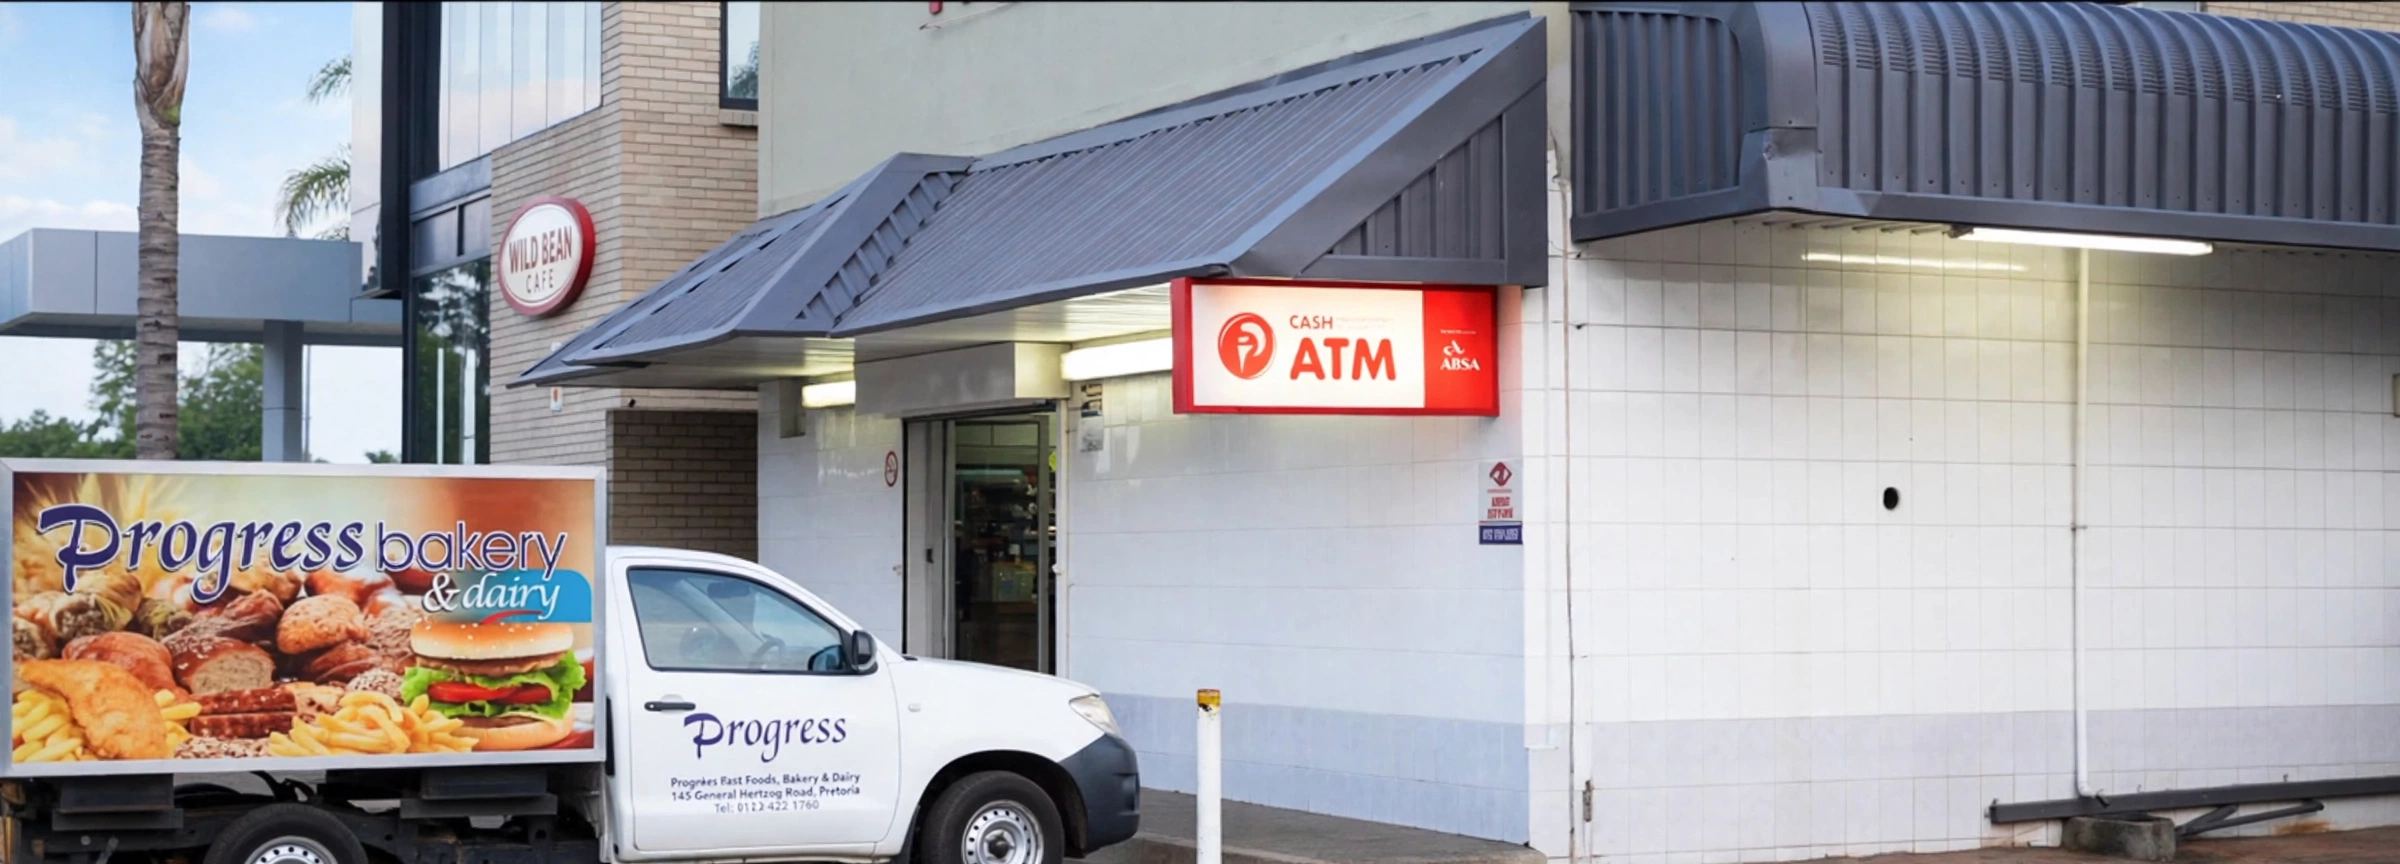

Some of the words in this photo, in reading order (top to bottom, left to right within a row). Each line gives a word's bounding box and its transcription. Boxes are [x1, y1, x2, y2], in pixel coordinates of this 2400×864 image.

[509, 236, 538, 274] WILD
[542, 226, 572, 265] BEAN
[526, 269, 554, 293] CAFE
[1289, 314, 1334, 330] CASH
[1289, 337, 1397, 381] ATM
[1439, 356, 1481, 372] ABSA
[37, 503, 365, 603] Progress
[376, 520, 568, 581] bakery
[422, 572, 461, 612] &
[462, 572, 561, 620] dairy
[683, 712, 847, 763] Progress
[782, 773, 819, 785] Bakery
[821, 772, 829, 782] &
[832, 771, 861, 784] Dairy
[671, 791, 692, 801] 145
[694, 789, 737, 800] General
[739, 788, 782, 800] Hertzog
[819, 784, 860, 797] Pretoria
[767, 800, 789, 811] 422
[793, 799, 820, 810] 1760
